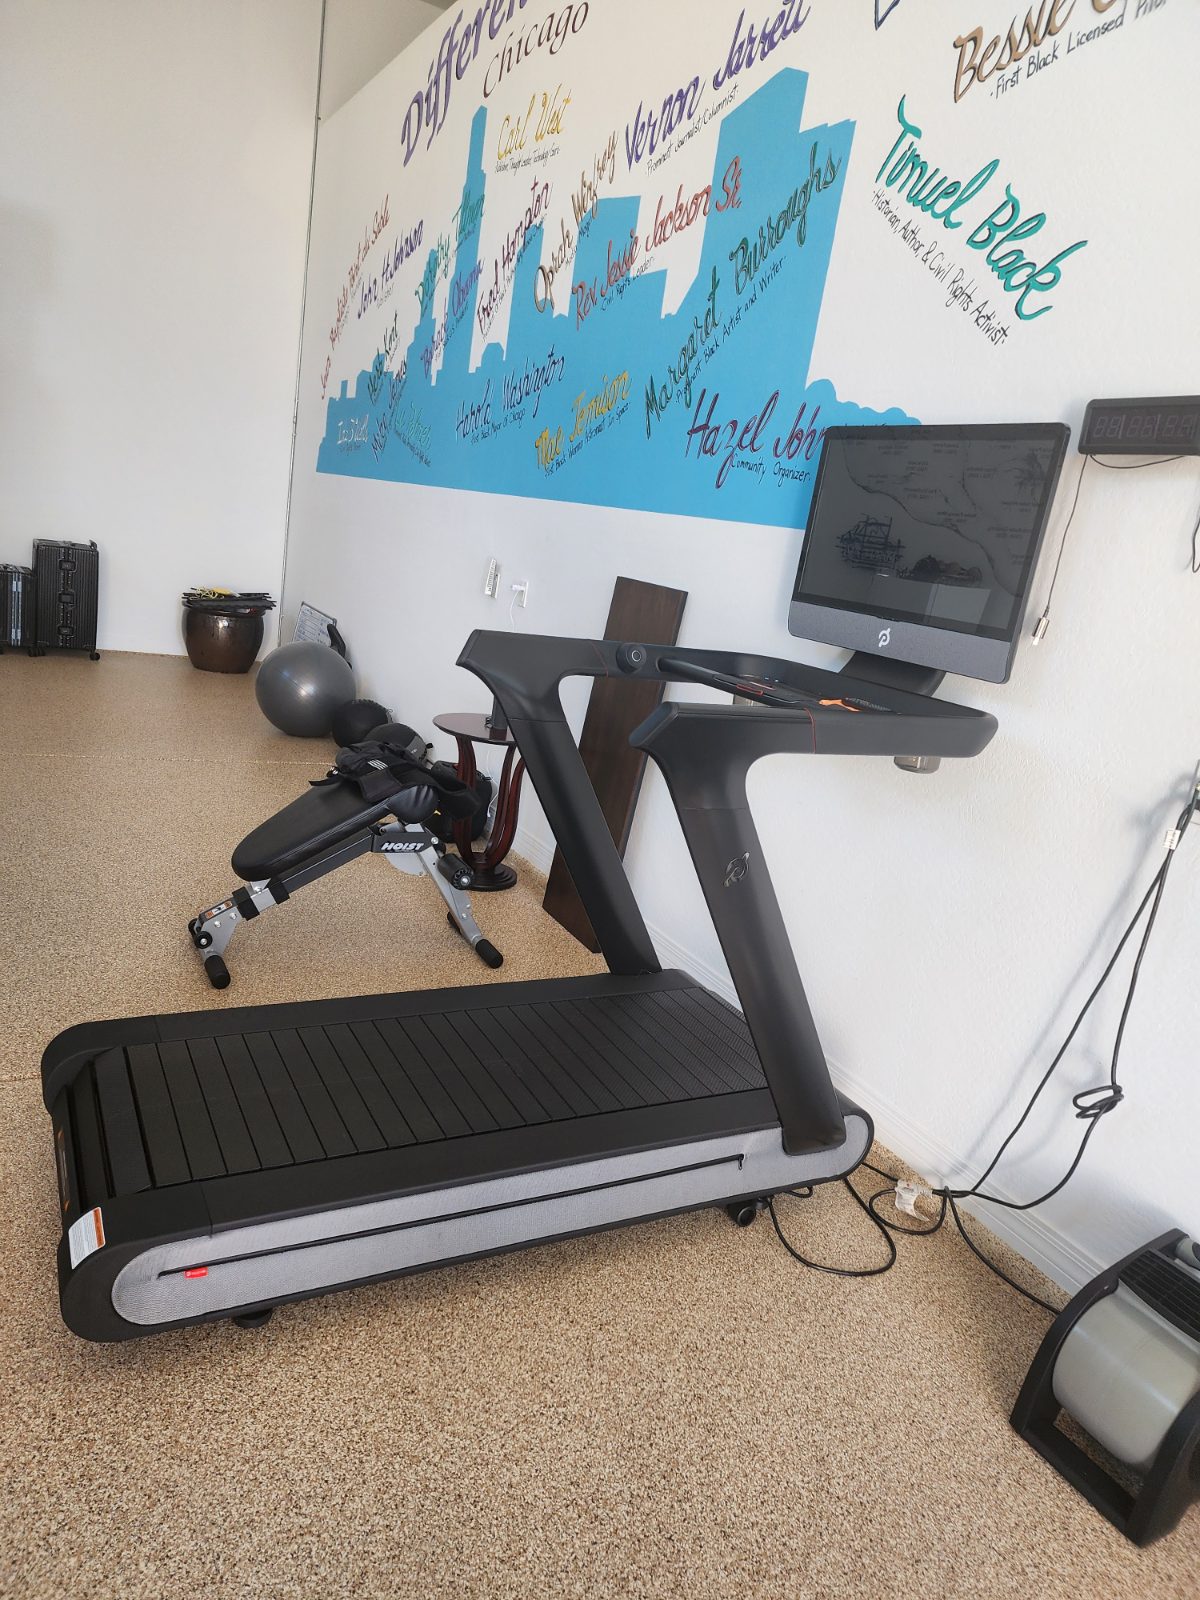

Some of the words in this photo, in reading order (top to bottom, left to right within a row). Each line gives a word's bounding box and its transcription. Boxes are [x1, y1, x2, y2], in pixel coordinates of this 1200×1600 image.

[483, 2, 589, 98] Chicago
[625, 75, 706, 172] Vernon
[712, 0, 811, 90] Jarrett
[996, 66, 1021, 99] First
[1027, 40, 1060, 78] Black
[1067, 0, 1128, 54] Licensed
[497, 93, 536, 160] Carl
[535, 83, 572, 142] West
[477, 257, 501, 336] Fred
[501, 175, 553, 273] Hampton
[534, 217, 574, 313] Oprah
[571, 130, 617, 228] Winfrey
[600, 228, 640, 297] Jessie
[645, 183, 712, 252] Jackson
[873, 188, 901, 234] Historian,
[899, 219, 924, 258] Author,
[921, 241, 937, 264] &
[929, 252, 955, 283] Civil
[946, 268, 977, 311] Rights
[875, 94, 1000, 229] Timuel
[966, 183, 1088, 320] Black
[358, 273, 378, 319] John
[645, 265, 721, 440] Margaret
[729, 140, 842, 296] Burroughs
[703, 337, 720, 364] Black
[722, 307, 743, 343] Artist
[744, 293, 757, 313] and
[456, 378, 496, 443] Harold
[502, 344, 565, 419] Washington
[535, 426, 564, 469] Mae
[569, 370, 632, 442] Jemison
[685, 388, 780, 489] Hazel
[773, 401, 826, 460] Joh
[731, 453, 767, 484] Community
[381, 842, 425, 851] HOIST
